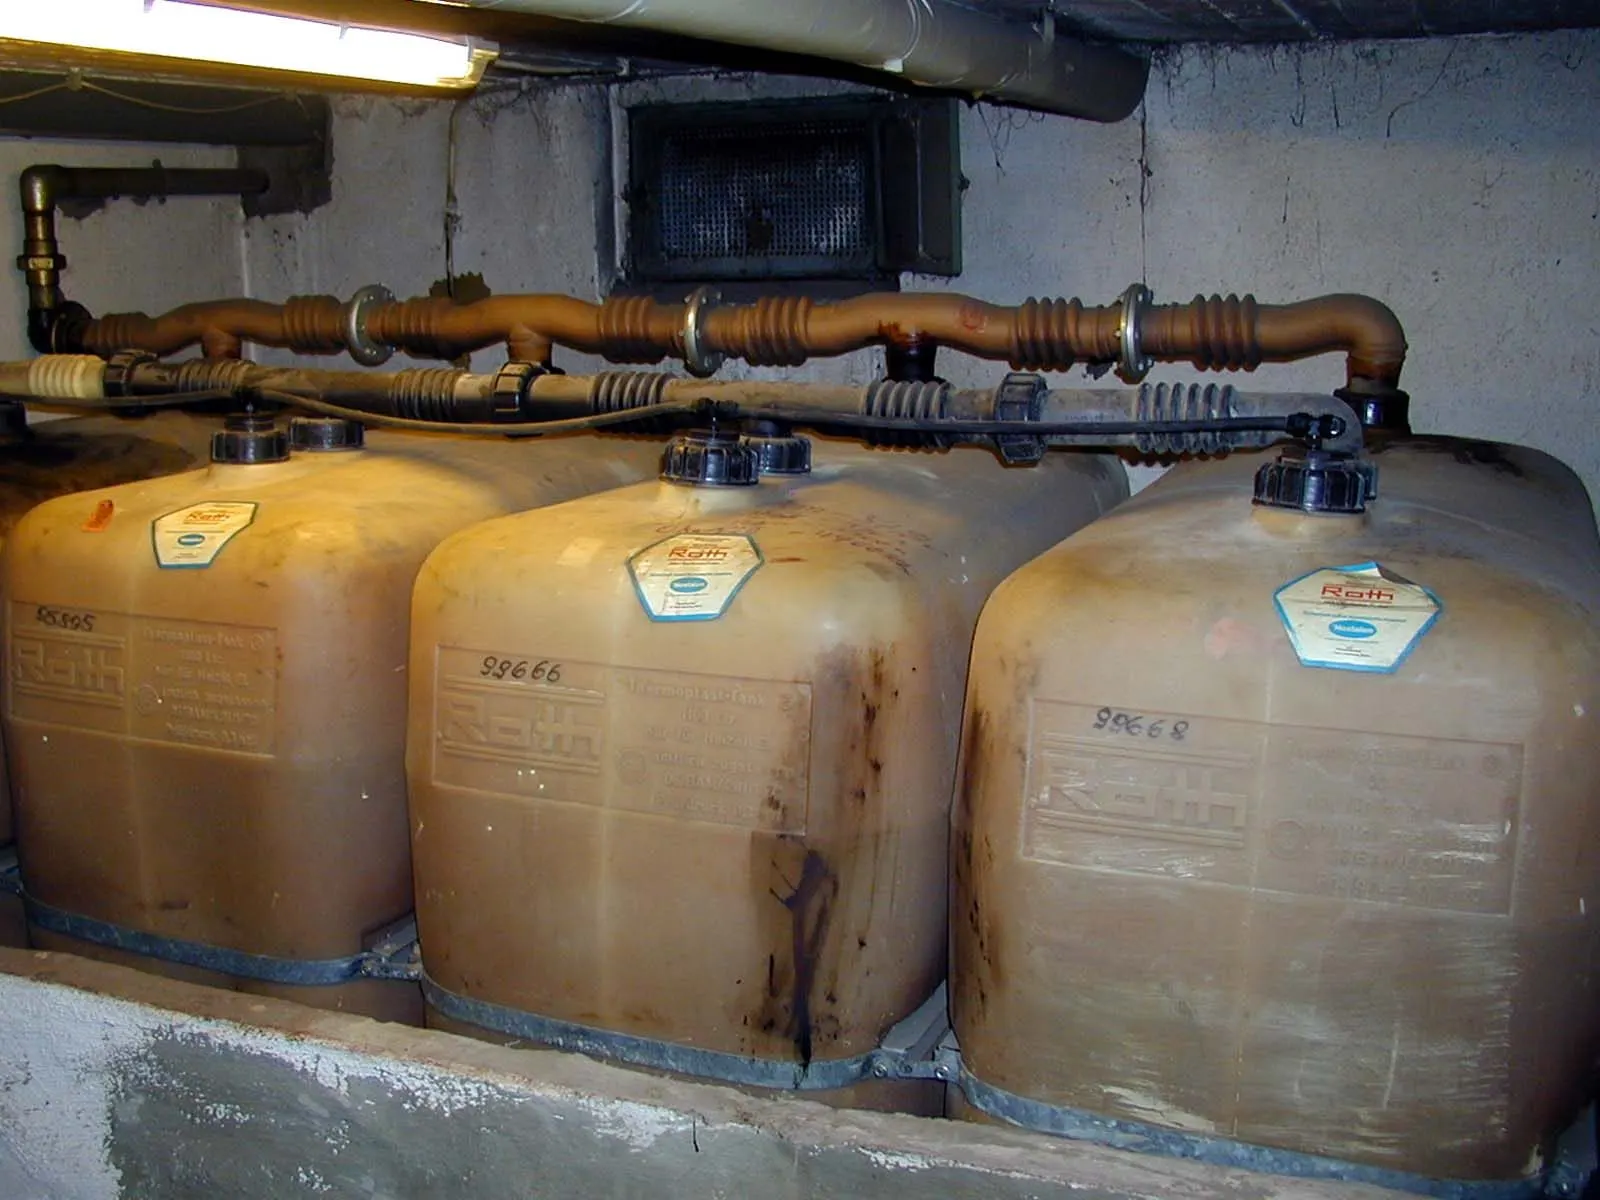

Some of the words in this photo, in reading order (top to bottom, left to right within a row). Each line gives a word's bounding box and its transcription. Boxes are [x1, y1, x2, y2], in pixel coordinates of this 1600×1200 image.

[667, 546, 728, 558] Roth
[1321, 585, 1393, 600] Roth
[480, 655, 561, 683] 99666
[440, 692, 601, 758] Roth
